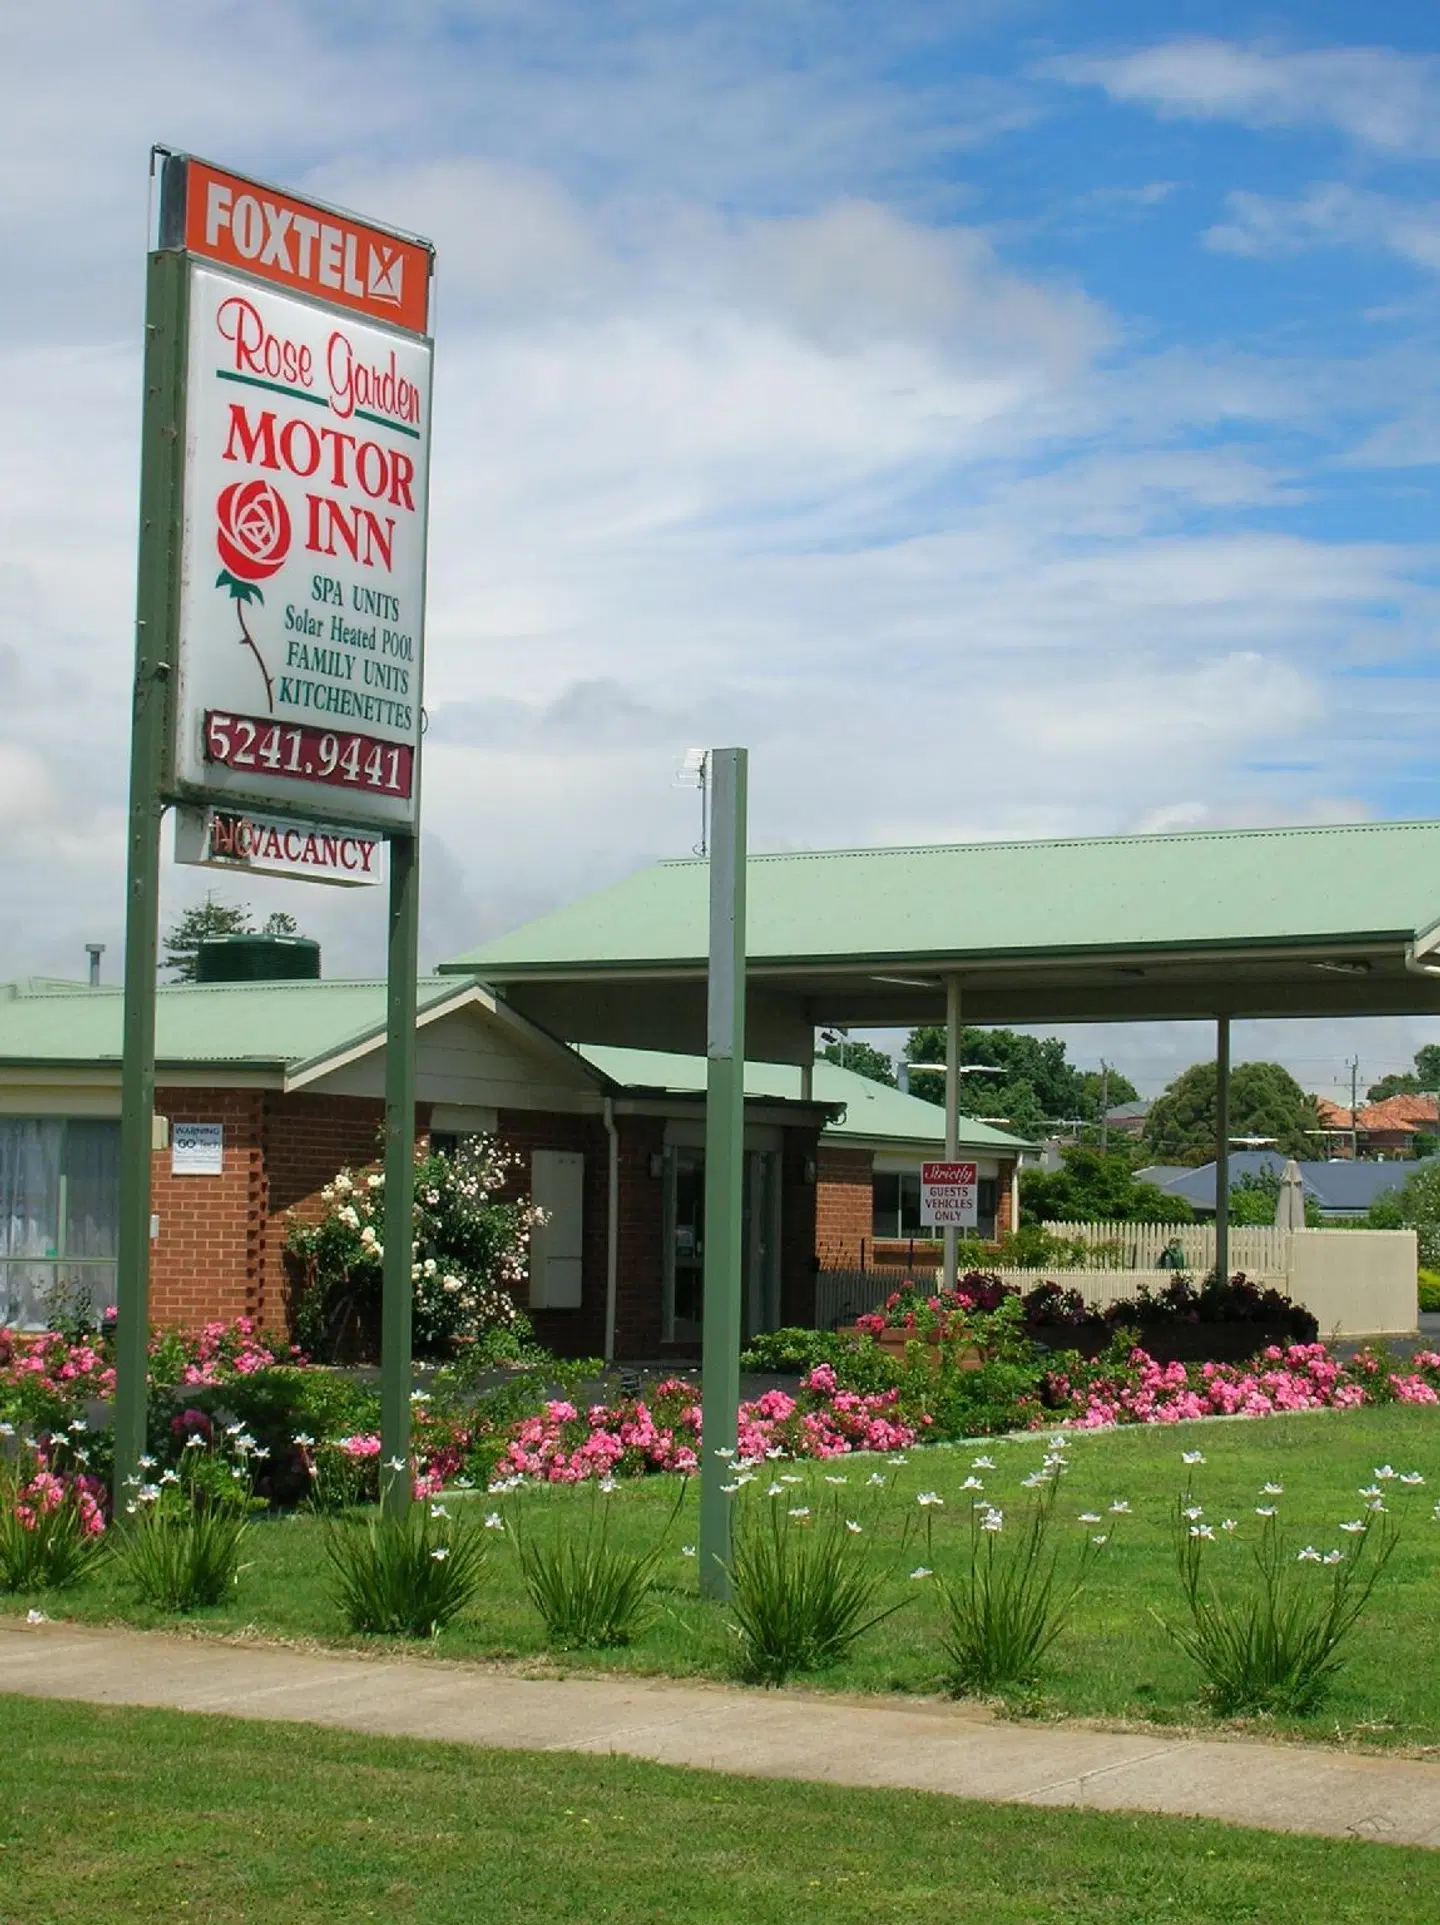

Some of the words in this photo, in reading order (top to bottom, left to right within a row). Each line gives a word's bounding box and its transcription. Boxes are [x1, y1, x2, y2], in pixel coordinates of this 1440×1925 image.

[206, 181, 364, 298] FOXTEL
[216, 296, 314, 388] Rose
[327, 331, 420, 424] Garden
[222, 403, 415, 512] MOTOR
[304, 493, 396, 573] INN
[311, 574, 344, 607] SPA
[352, 585, 400, 622] UNITS
[284, 603, 324, 637] Solar
[330, 615, 376, 651] Heated
[382, 628, 414, 662] POOL
[286, 640, 356, 680] FAMILY
[363, 659, 410, 695] UNITS
[279, 676, 412, 730] KITCHENETTES
[208, 715, 401, 790] 5241.9441
[250, 823, 375, 872] VACANCY
[175, 1126, 220, 1135] WARNING
[924, 1164, 973, 1185] Strictly
[930, 1187, 969, 1197] GUESTS
[924, 1198, 973, 1209] VEHICLES
[934, 1211, 962, 1221] ONLY
